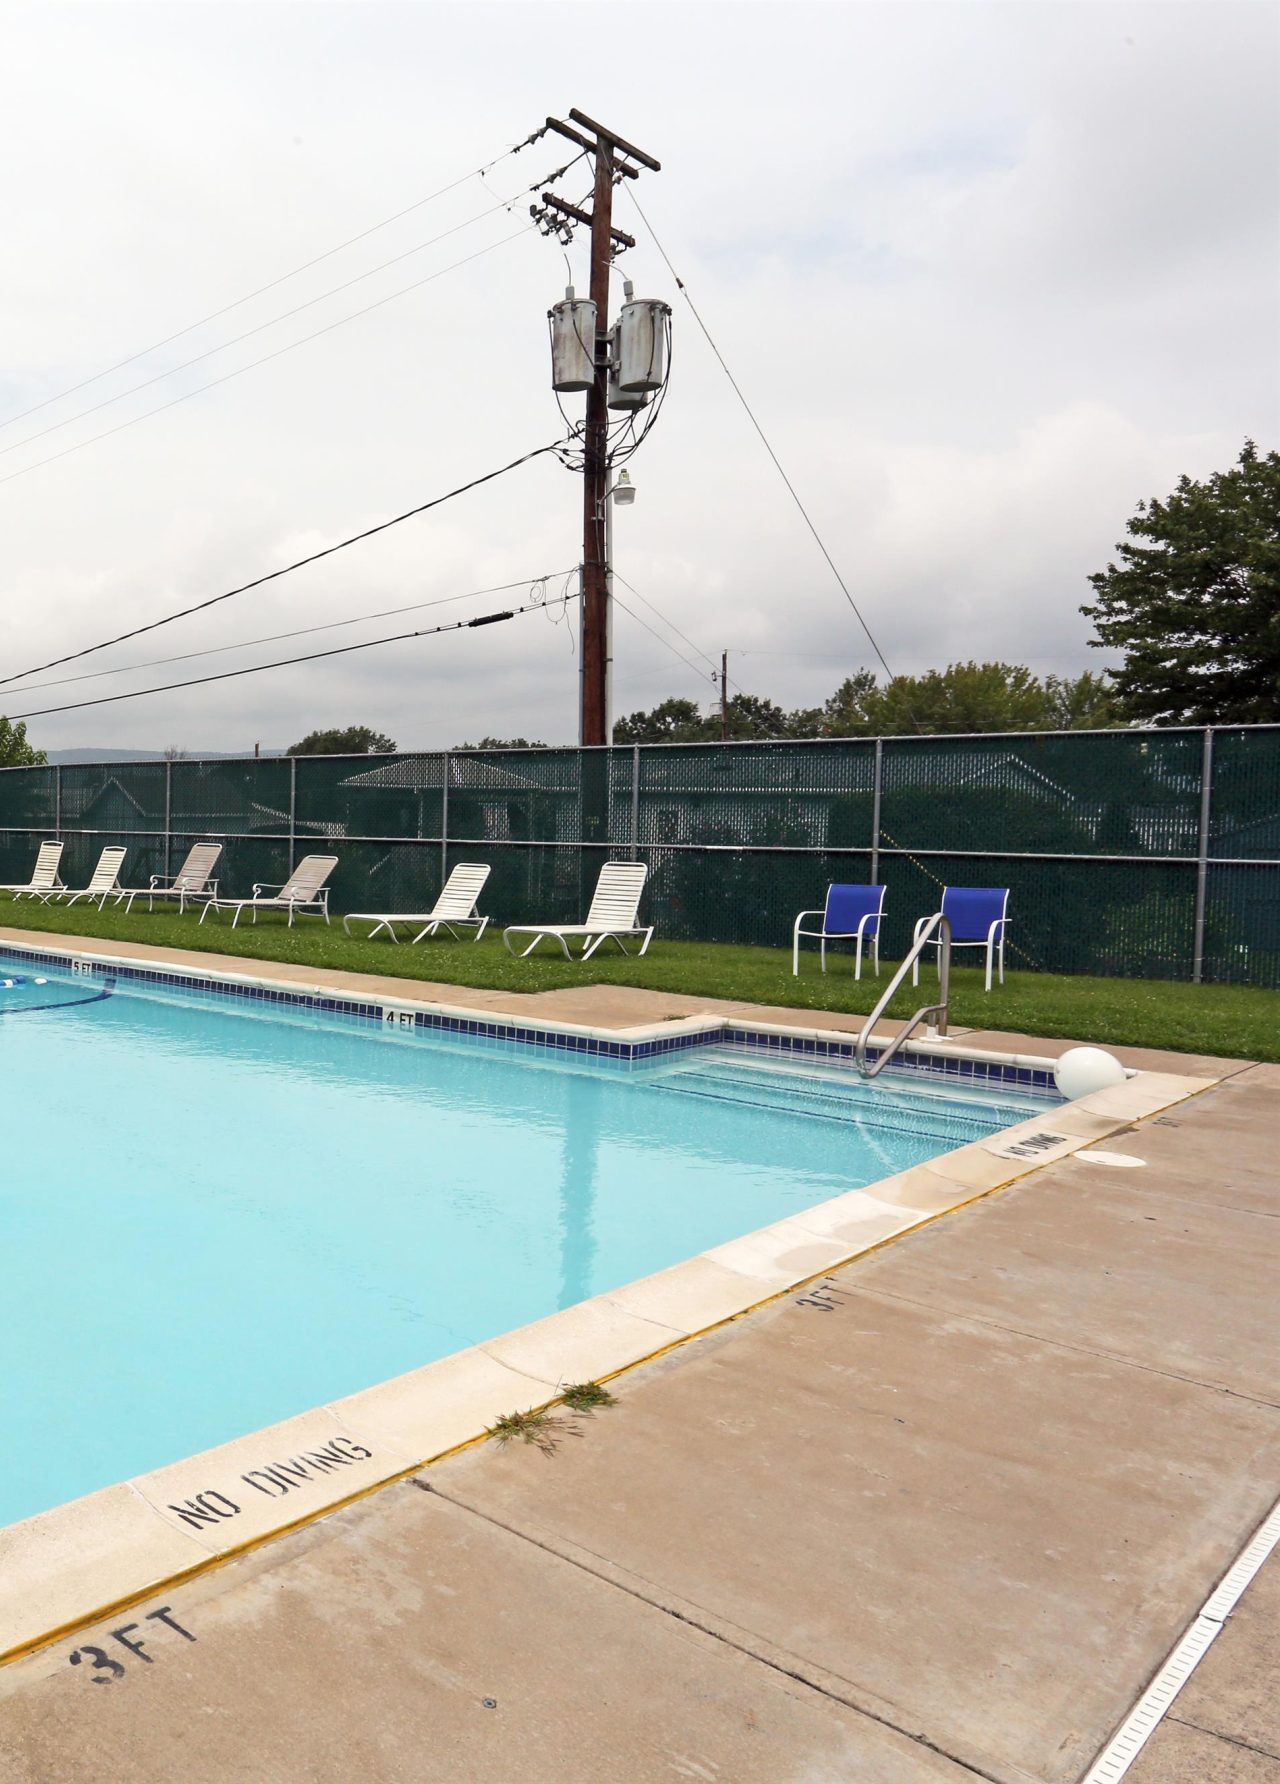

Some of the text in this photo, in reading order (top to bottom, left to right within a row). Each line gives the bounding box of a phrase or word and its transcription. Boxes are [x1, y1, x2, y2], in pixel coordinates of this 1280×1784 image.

[74, 961, 90, 971] 5 FT
[386, 1011, 414, 1025] 4 FT
[167, 1437, 373, 1530] NO DIVING
